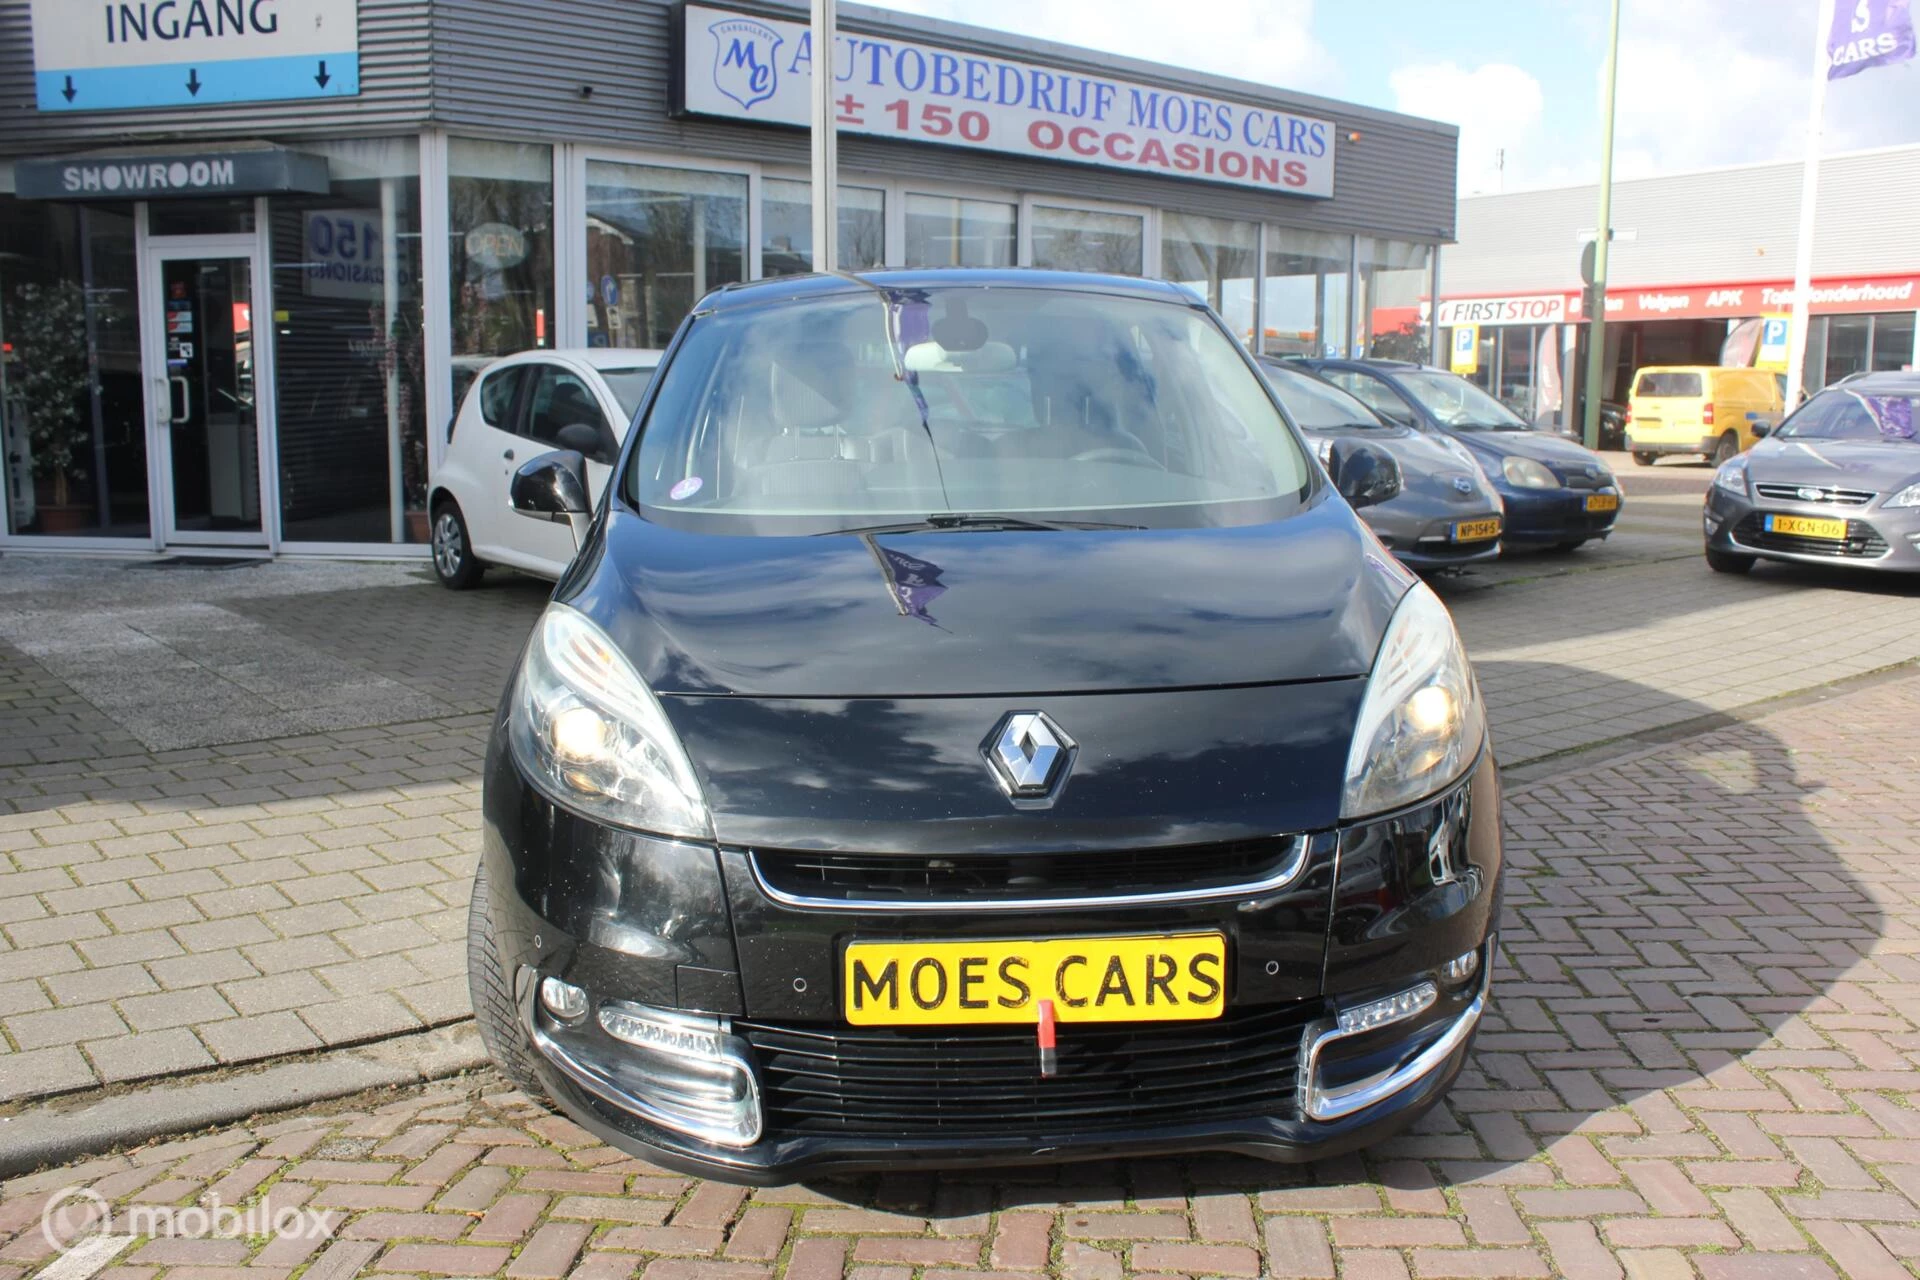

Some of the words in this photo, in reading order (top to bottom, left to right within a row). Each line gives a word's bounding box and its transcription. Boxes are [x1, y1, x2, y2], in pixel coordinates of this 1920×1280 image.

[106, 0, 278, 43] INGANG
[1832, 32, 1898, 66] CARS
[1128, 88, 1233, 142] MOES
[1243, 111, 1326, 158] CARS
[885, 99, 990, 142] 150
[1028, 120, 1308, 187] OCCASIONS
[64, 160, 235, 192] SHOWROOM
[465, 232, 524, 258] OPEN
[1705, 290, 1744, 308] APK
[1460, 521, 1497, 538] NP-154-S
[1776, 518, 1840, 536] 1-XGN-06
[852, 956, 1031, 1011] MOES
[1055, 953, 1222, 1008] CARS
